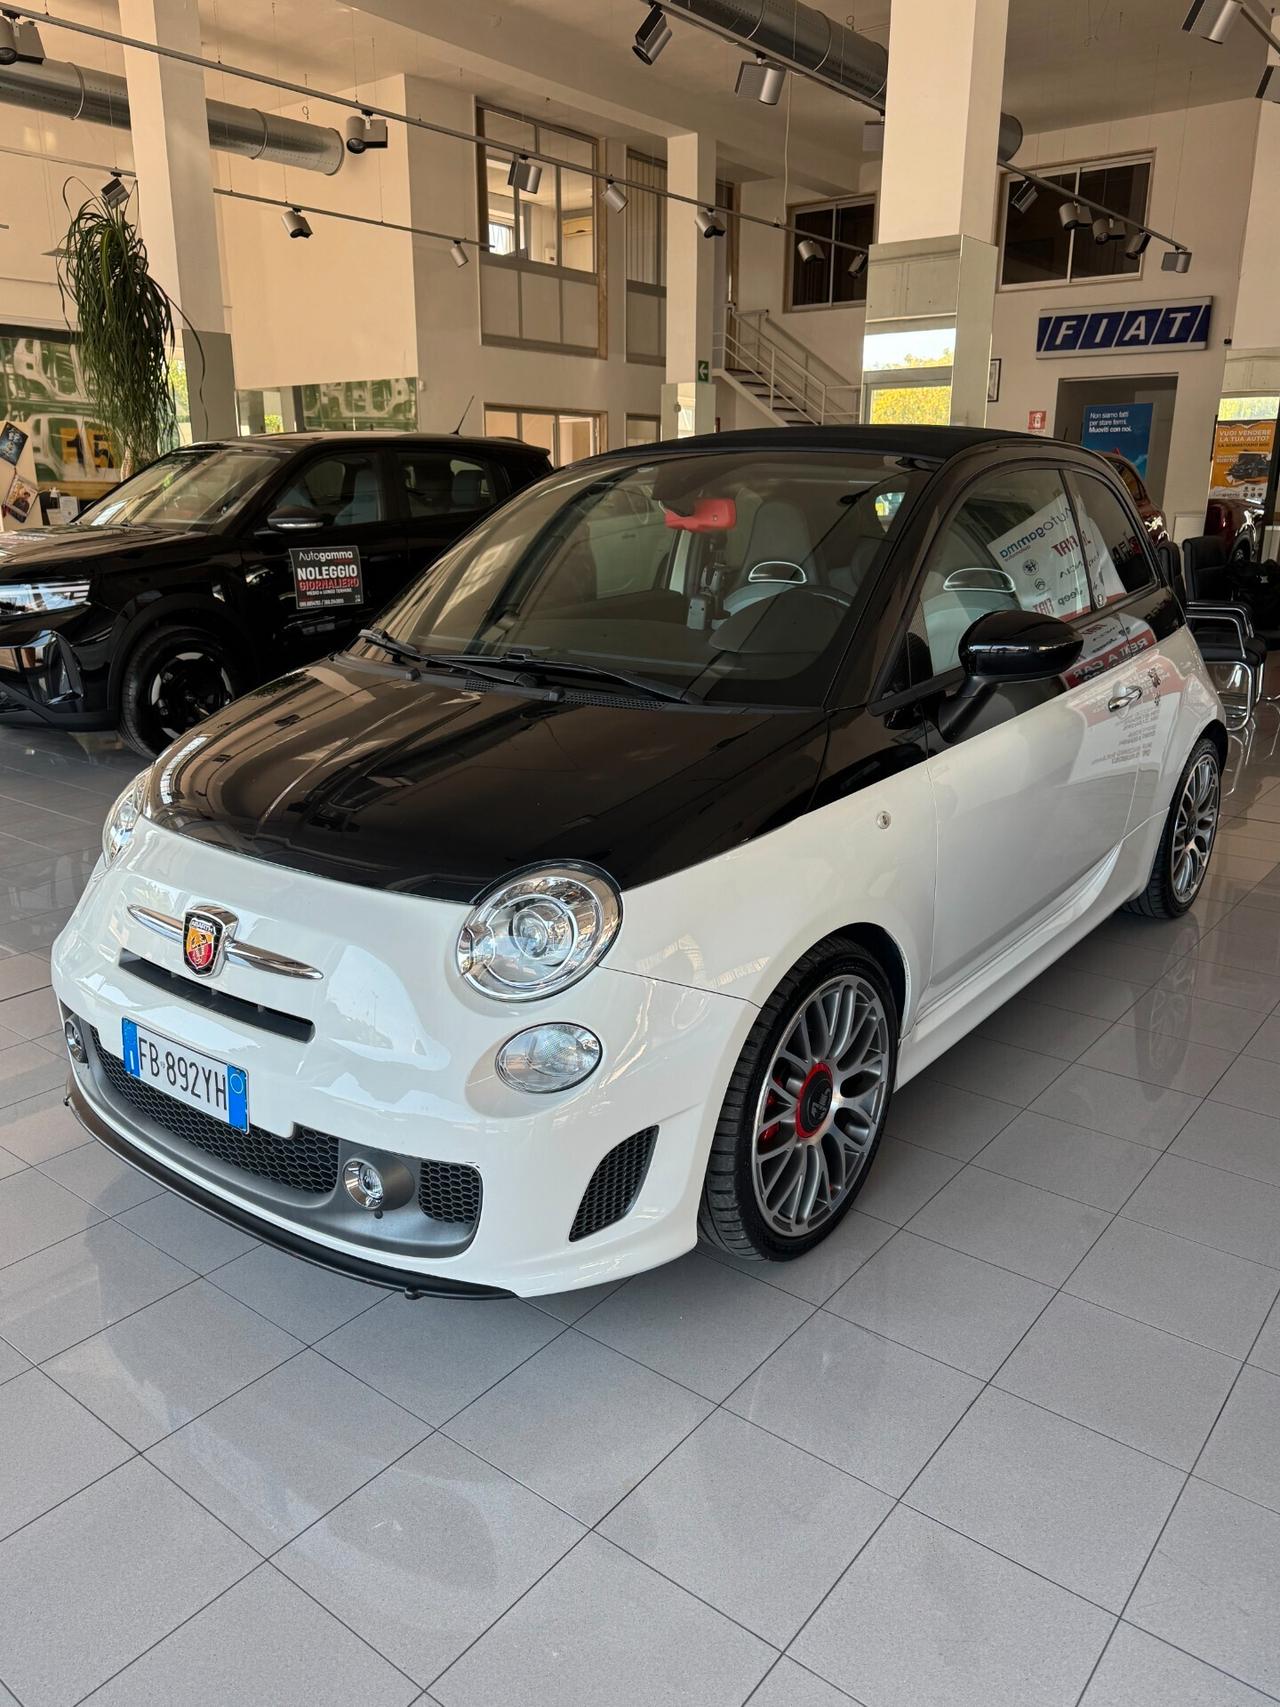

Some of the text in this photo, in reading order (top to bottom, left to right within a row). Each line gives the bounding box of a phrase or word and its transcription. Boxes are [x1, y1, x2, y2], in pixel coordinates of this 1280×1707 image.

[1055, 312, 1191, 346] FIAT
[300, 551, 353, 562] Autogamma
[298, 565, 358, 580] NOLEGGIO
[300, 578, 360, 591] GIORNALIERO
[138, 1036, 228, 1111] FB 892YH
